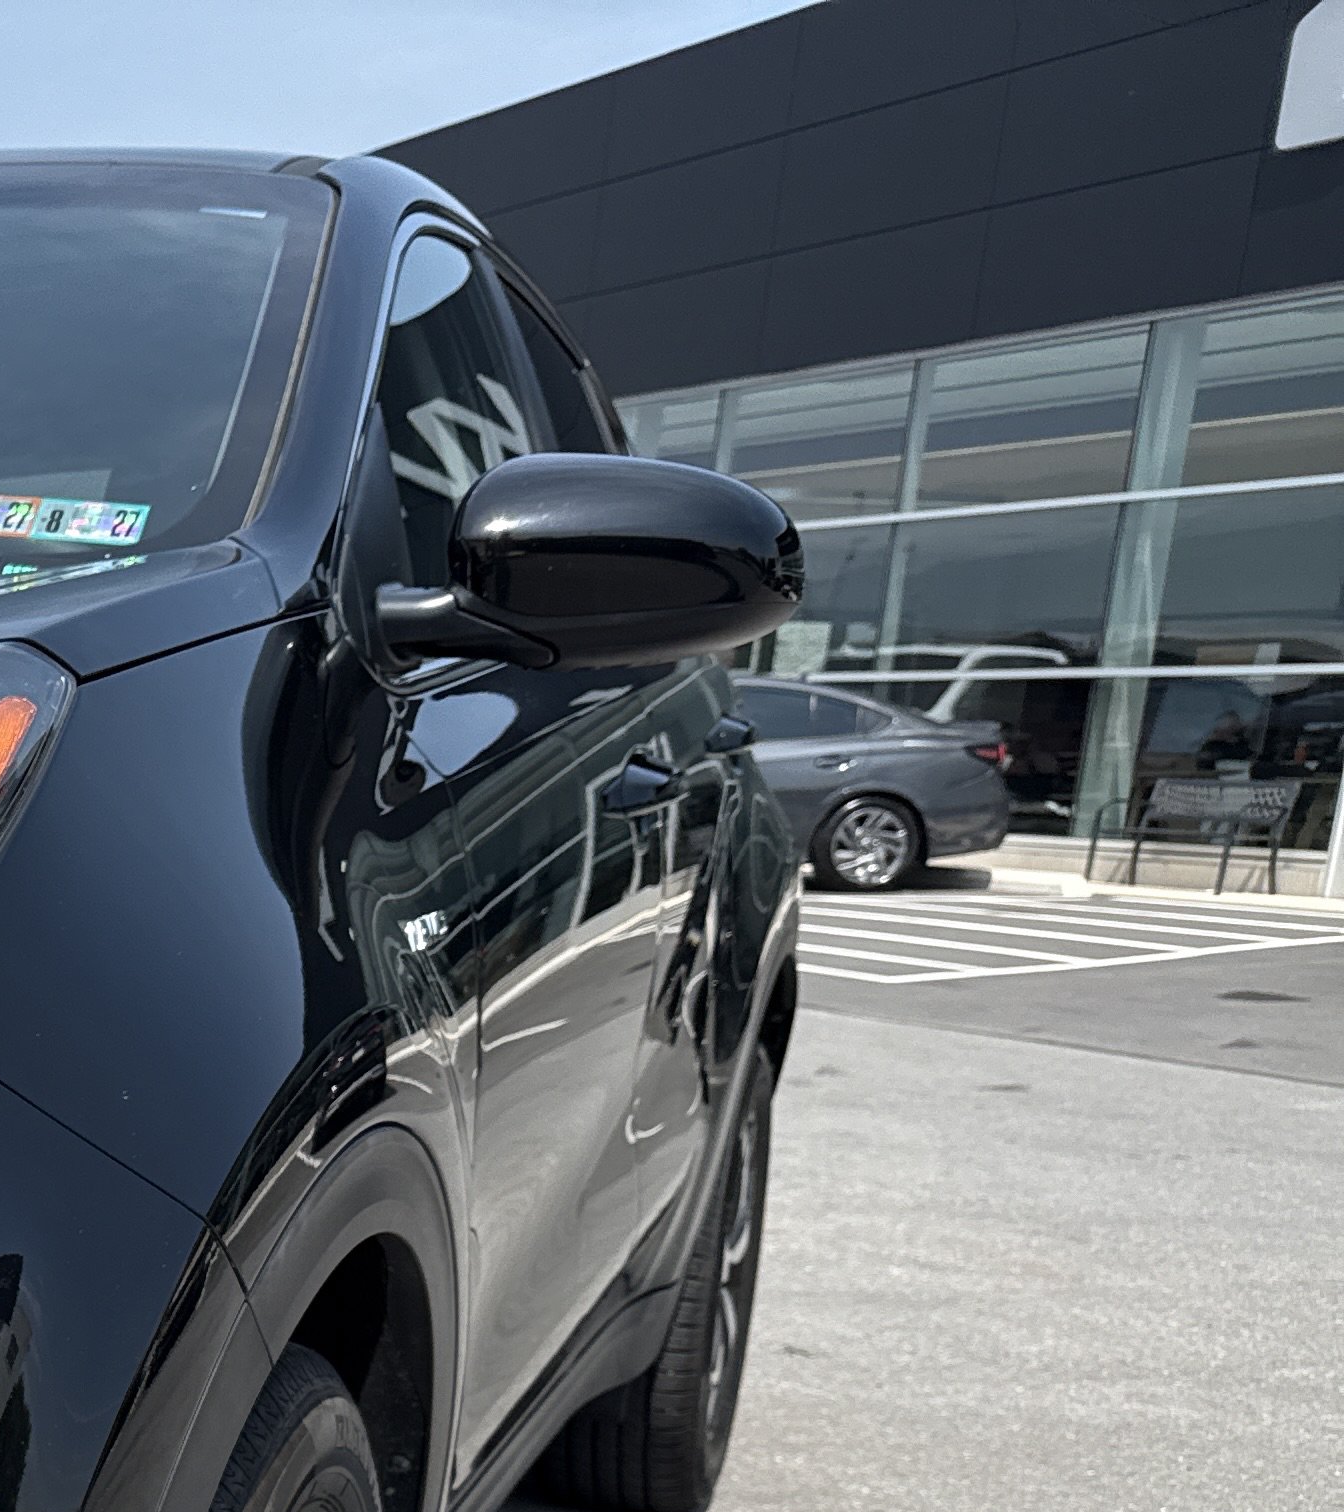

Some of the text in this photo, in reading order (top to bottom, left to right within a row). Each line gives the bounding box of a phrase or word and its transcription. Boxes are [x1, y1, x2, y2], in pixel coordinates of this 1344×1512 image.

[2, 502, 32, 532] 27
[45, 509, 140, 537] 8 27
